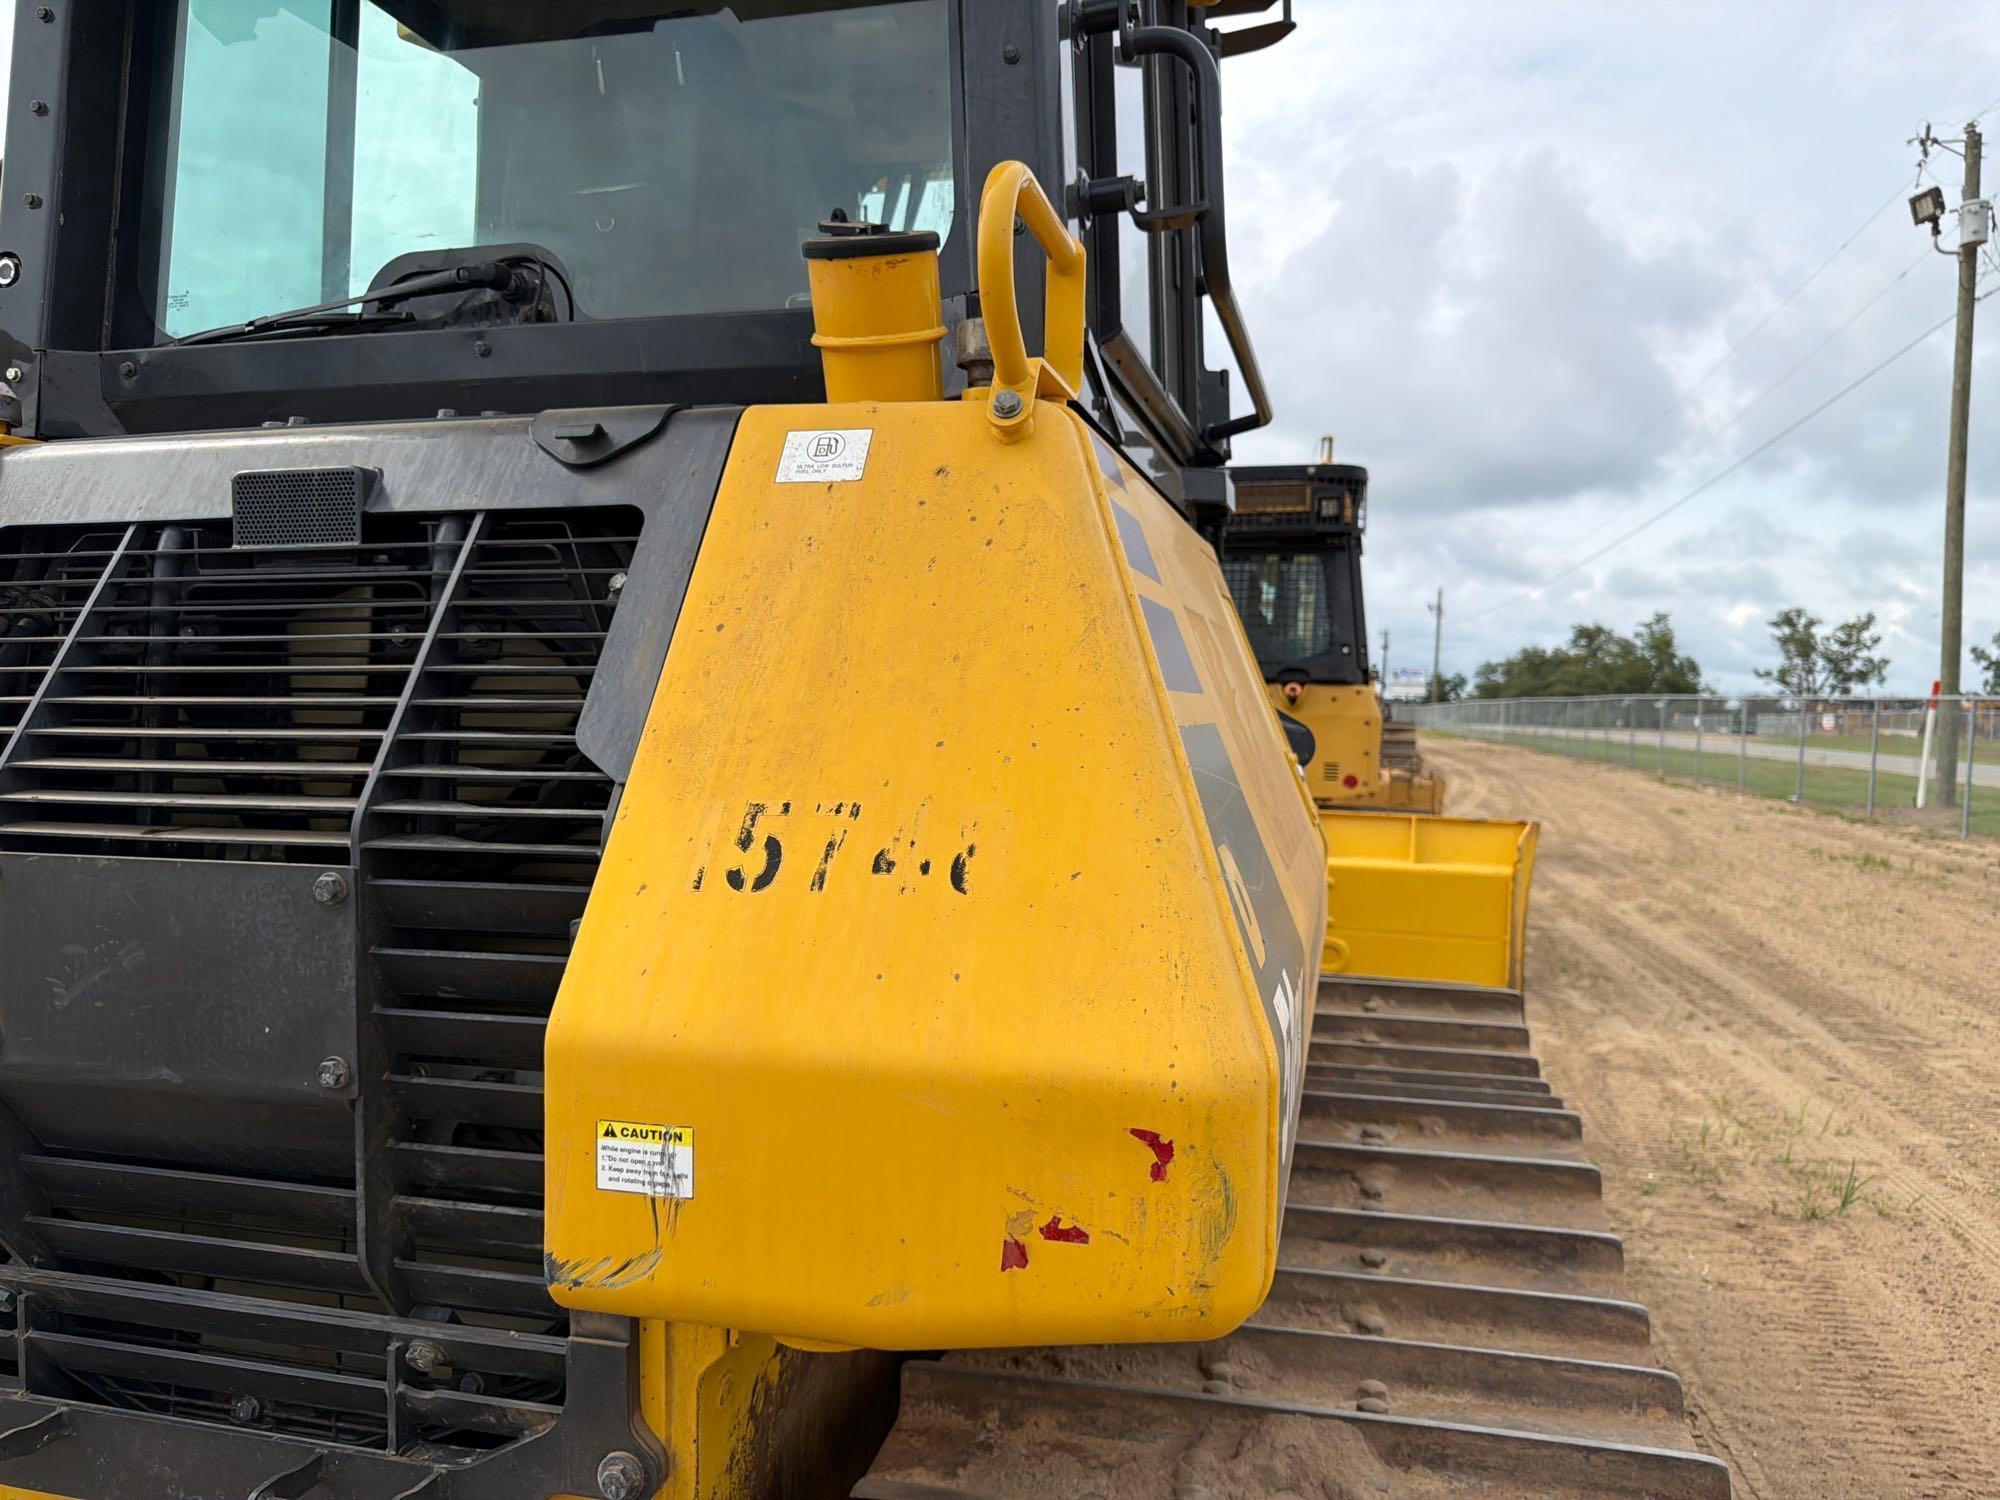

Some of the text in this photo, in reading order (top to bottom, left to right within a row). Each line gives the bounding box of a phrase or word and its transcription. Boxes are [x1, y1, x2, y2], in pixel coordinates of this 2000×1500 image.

[620, 1127, 683, 1142] CAUTION
[620, 1147, 641, 1155] engine
[608, 1166, 625, 1174] Keep
[625, 1168, 642, 1176] away
[621, 1177, 646, 1186] rotating
